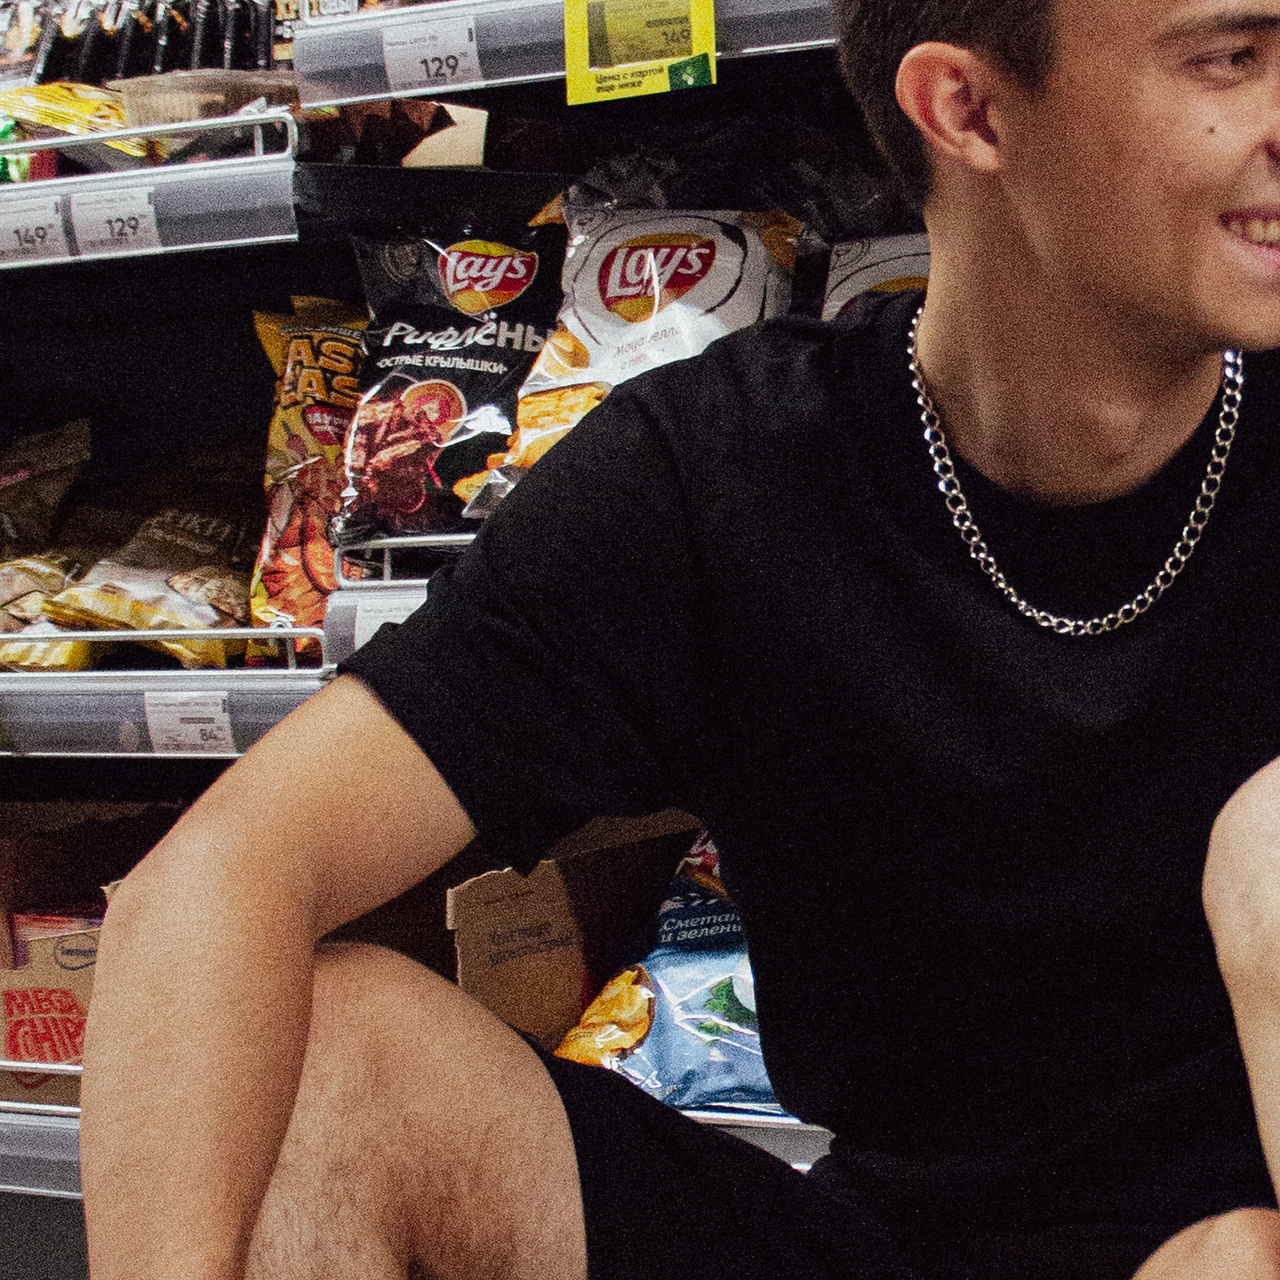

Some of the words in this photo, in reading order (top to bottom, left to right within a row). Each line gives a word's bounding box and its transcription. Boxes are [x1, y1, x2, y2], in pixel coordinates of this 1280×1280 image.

[419, 54, 459, 79] 129
[12, 225, 48, 247] 149
[105, 215, 140, 237] 129
[660, 912, 741, 932] Сметан
[4, 1017, 88, 1063] CHIP
